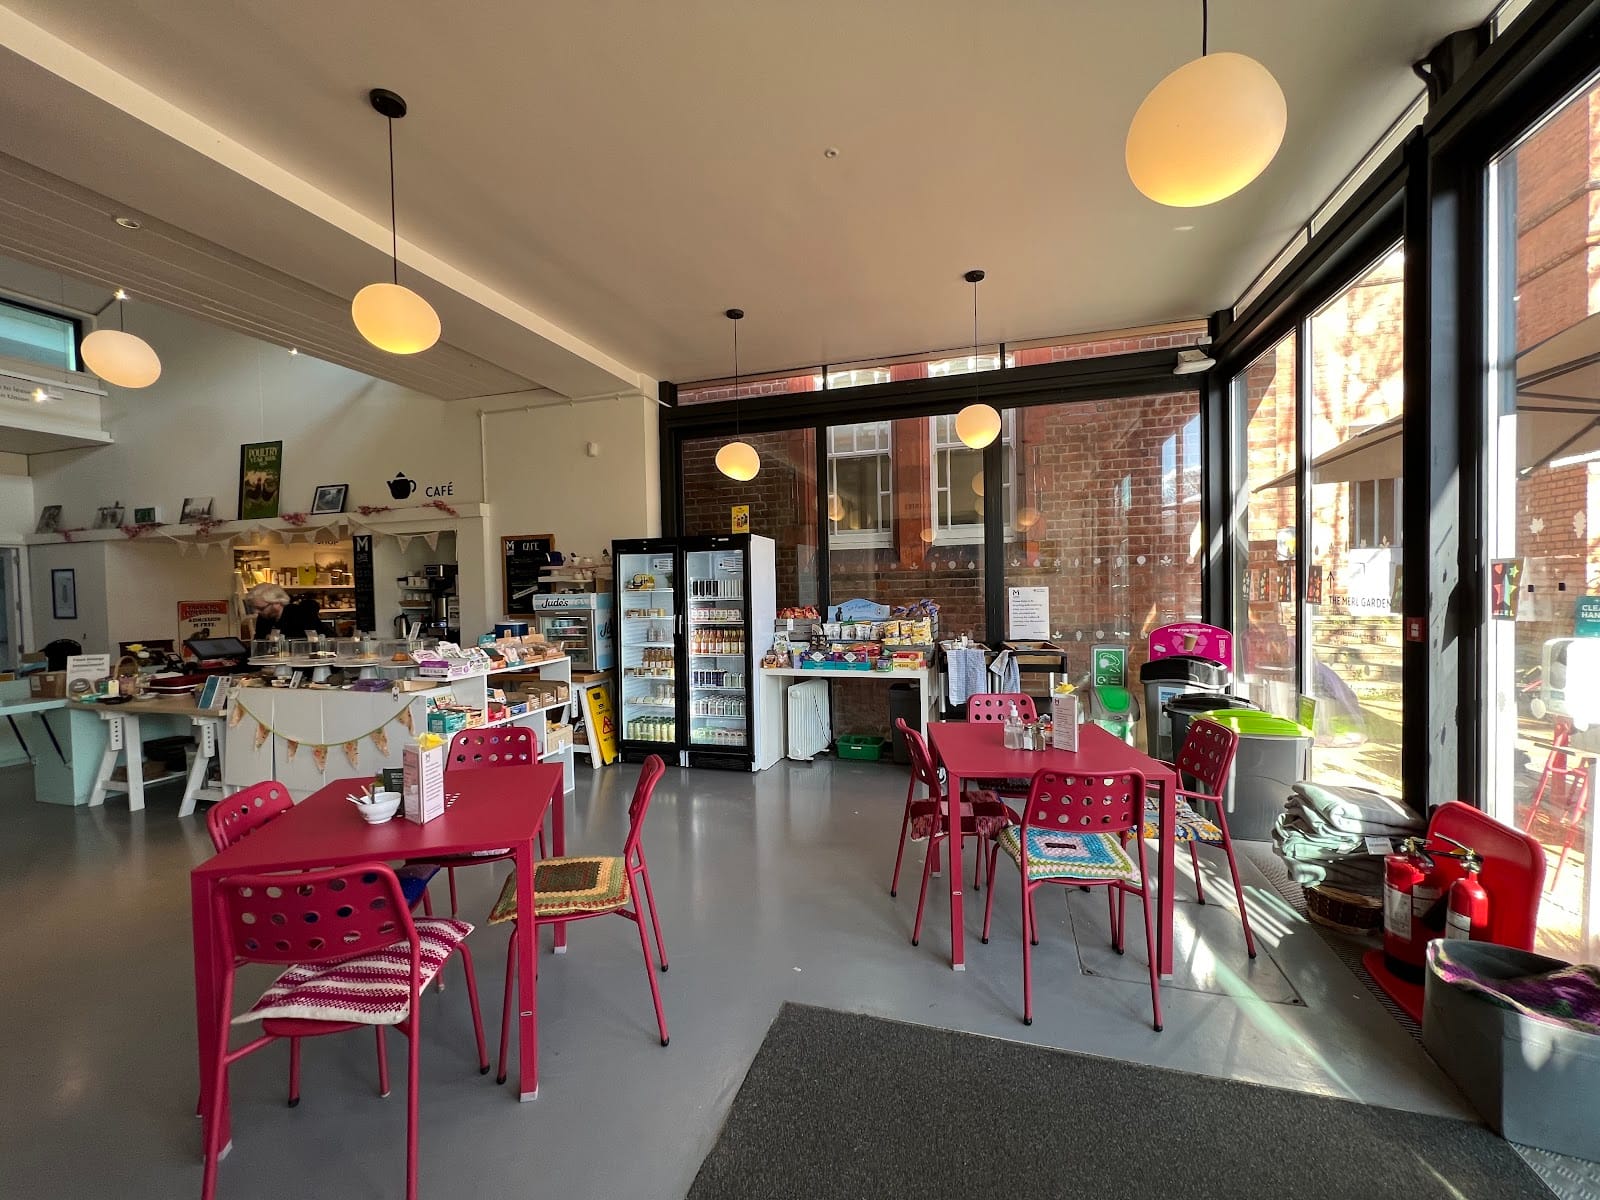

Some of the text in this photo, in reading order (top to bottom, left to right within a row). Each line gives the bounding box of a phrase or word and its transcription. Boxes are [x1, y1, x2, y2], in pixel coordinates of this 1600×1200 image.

[248, 447, 277, 459] POULTRY
[425, 481, 454, 497] CAFÉ
[356, 536, 369, 552] M
[541, 598, 569, 608] Jude's
[1328, 596, 1392, 608] THE MERL GARDEN
